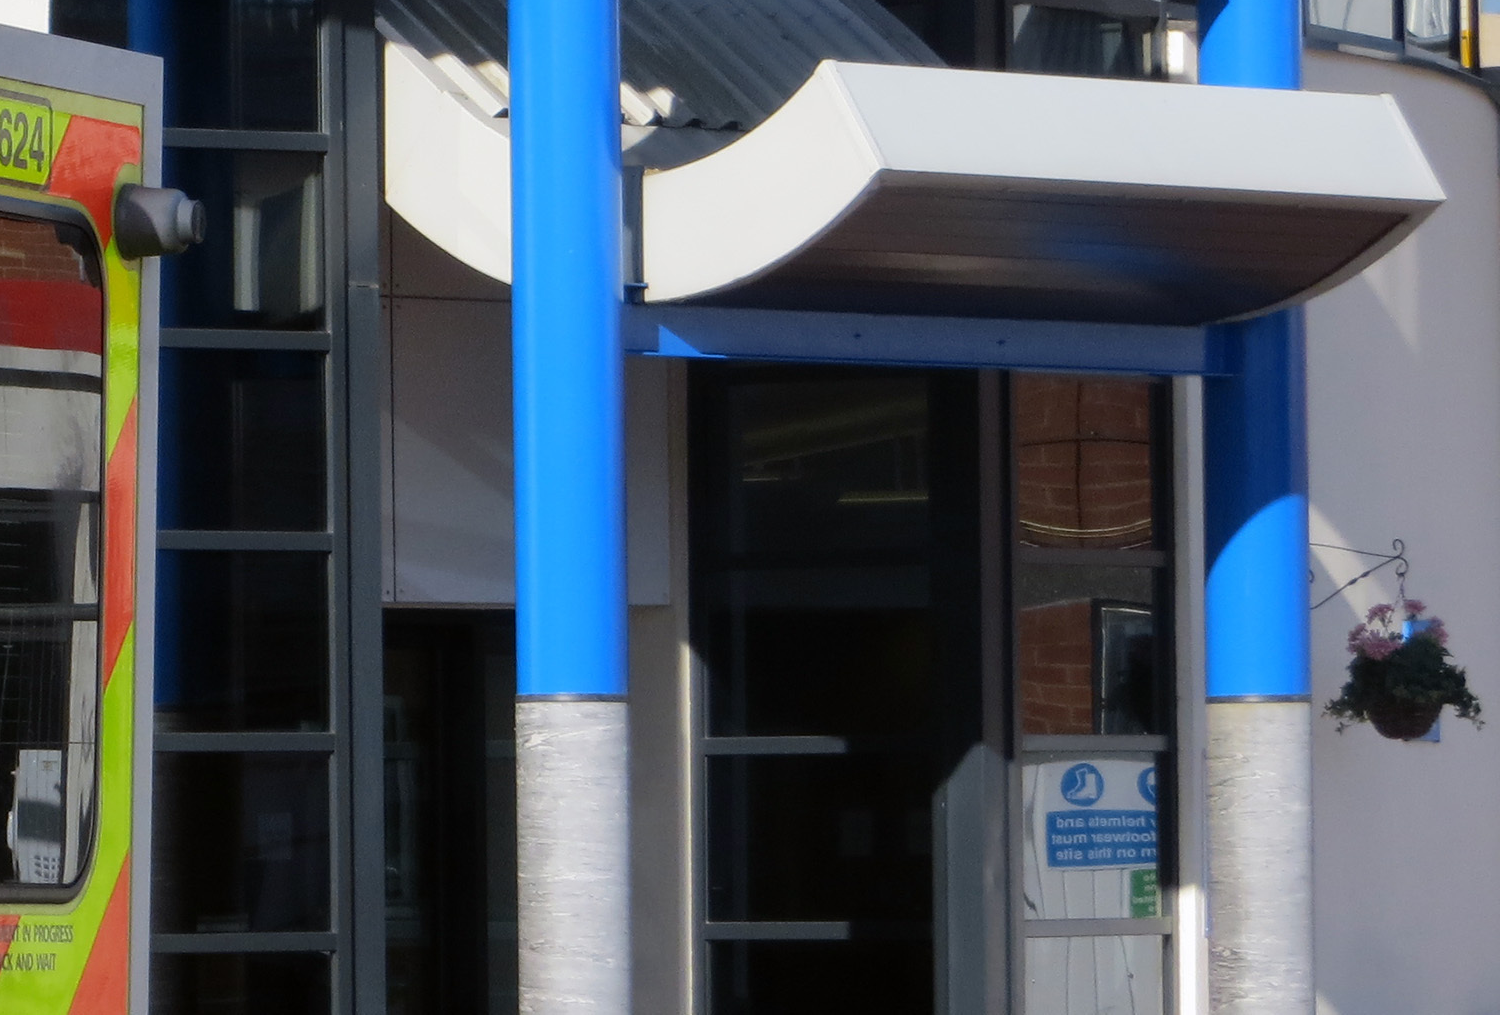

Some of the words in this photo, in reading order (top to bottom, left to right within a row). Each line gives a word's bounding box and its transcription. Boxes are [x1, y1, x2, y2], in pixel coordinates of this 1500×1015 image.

[22, 924, 32, 943] IN
[33, 924, 74, 943] PROGRESS
[15, 953, 34, 971] AND
[36, 953, 57, 971] WAIT
